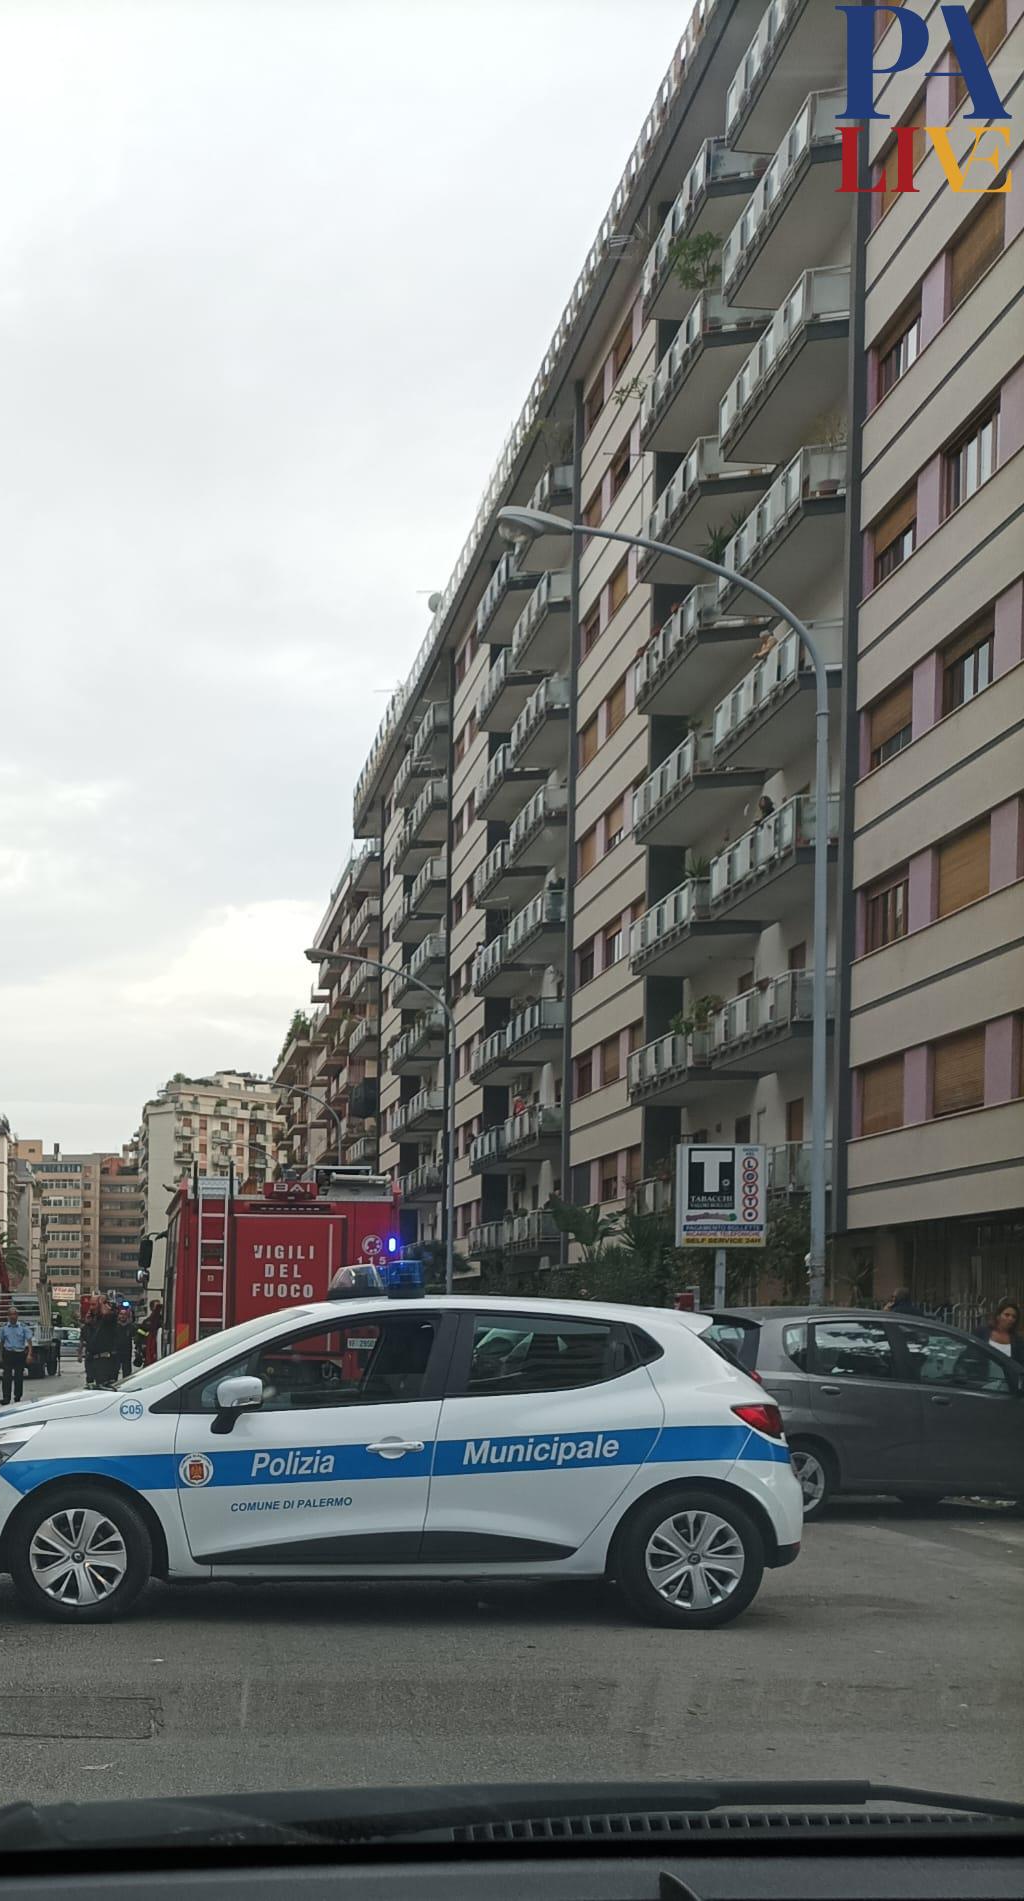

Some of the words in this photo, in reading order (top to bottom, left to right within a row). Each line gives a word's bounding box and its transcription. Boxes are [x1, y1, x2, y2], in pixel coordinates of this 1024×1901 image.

[273, 1183, 311, 1192] BAI
[690, 1195, 733, 1203] TABACCHI
[253, 1245, 315, 1260] VIGILI
[264, 1264, 303, 1279] DEL
[252, 1284, 314, 1298] FUOCO
[120, 1404, 142, 1415] C05
[462, 1434, 619, 1465] Municipale
[251, 1450, 335, 1477] Polizia
[230, 1501, 280, 1512] COMUNE
[282, 1499, 295, 1510] DI
[296, 1496, 353, 1509] PALERMO
